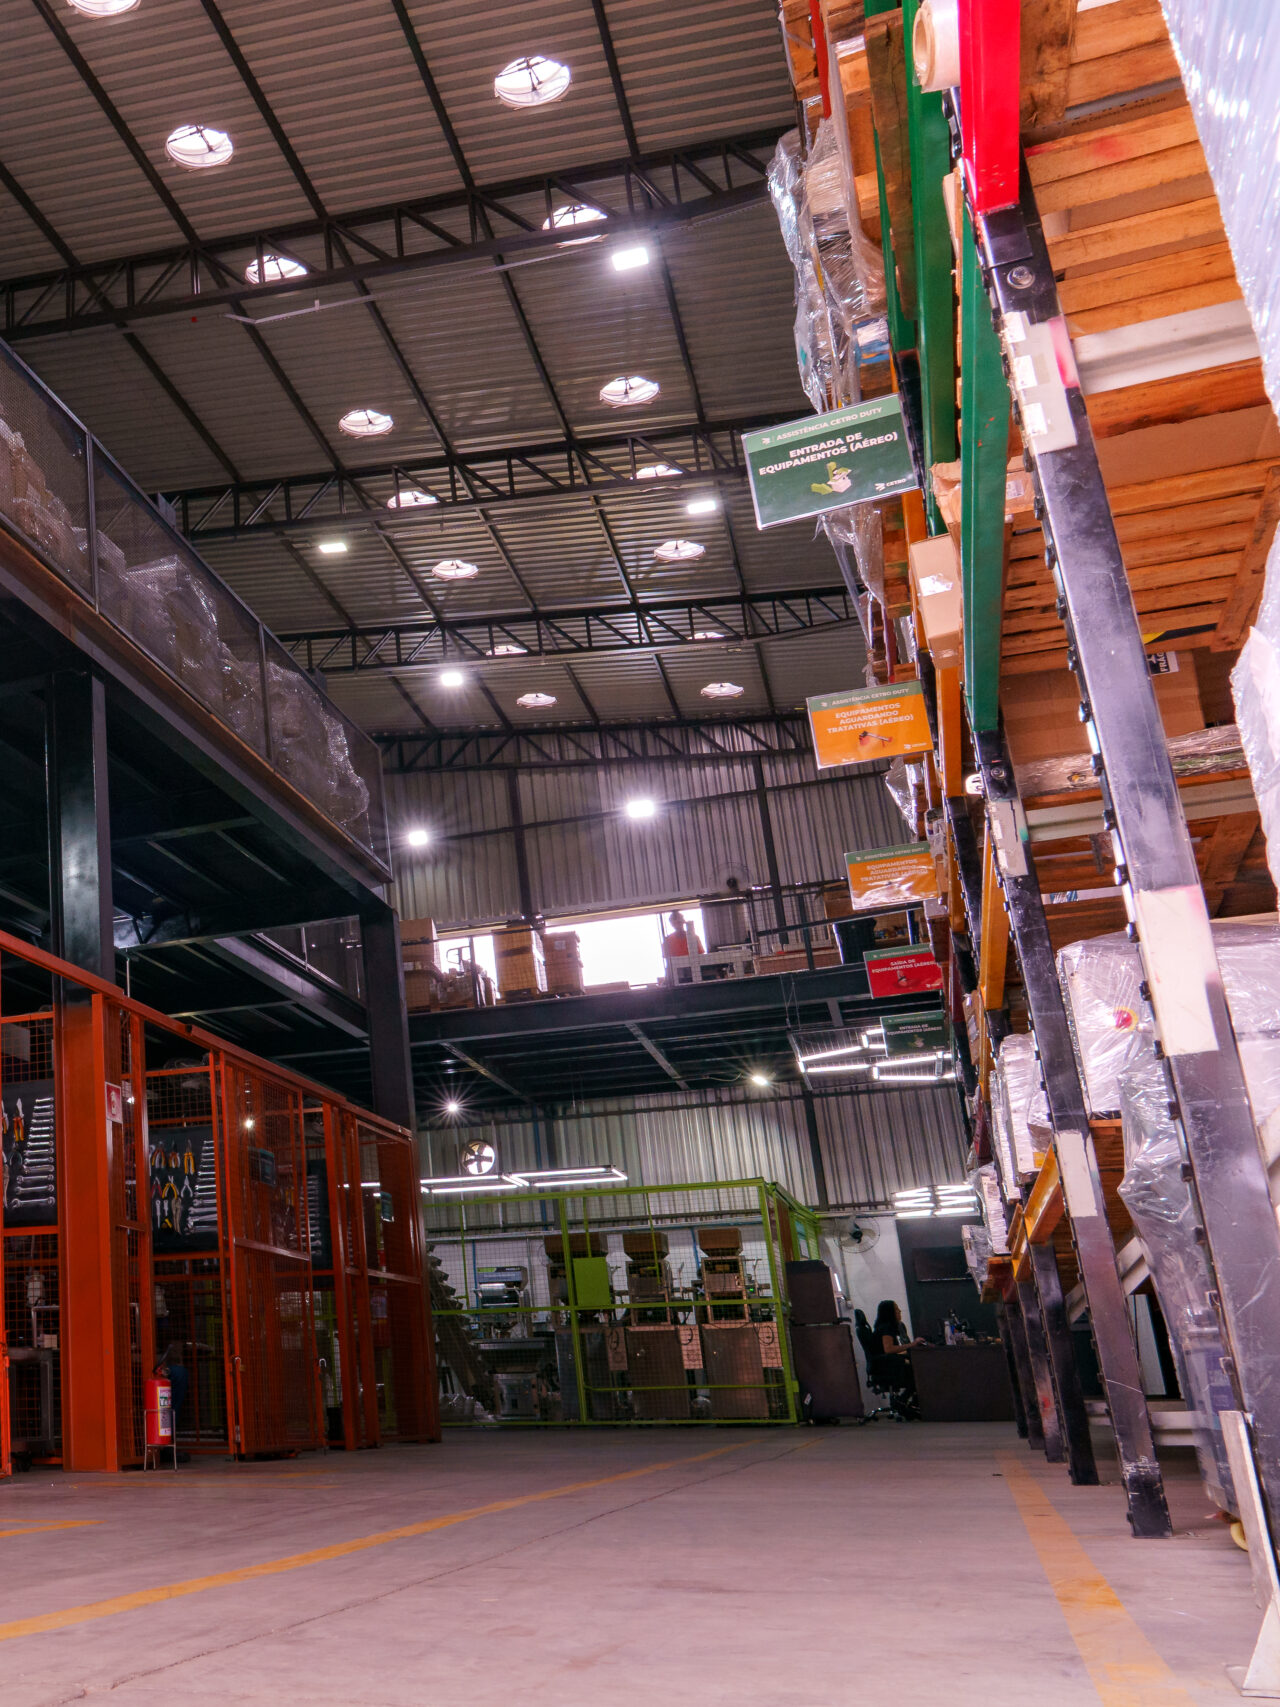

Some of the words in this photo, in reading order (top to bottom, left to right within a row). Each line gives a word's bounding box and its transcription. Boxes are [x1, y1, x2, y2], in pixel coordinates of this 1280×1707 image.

[777, 422, 829, 440] ASSISTÊNCIA
[830, 414, 857, 425] CETRO
[860, 407, 881, 417] DUTY
[759, 446, 847, 475] EQUIPAMENTOS
[850, 432, 897, 451] (AÉREO)
[790, 438, 844, 457] ENTRADA
[846, 433, 862, 442] DE
[836, 703, 900, 718] EQUIPAMENTOS
[840, 711, 898, 724] AGUARDANDO
[828, 720, 878, 732] TRATATIVAS
[879, 714, 913, 725] (AÉREO)
